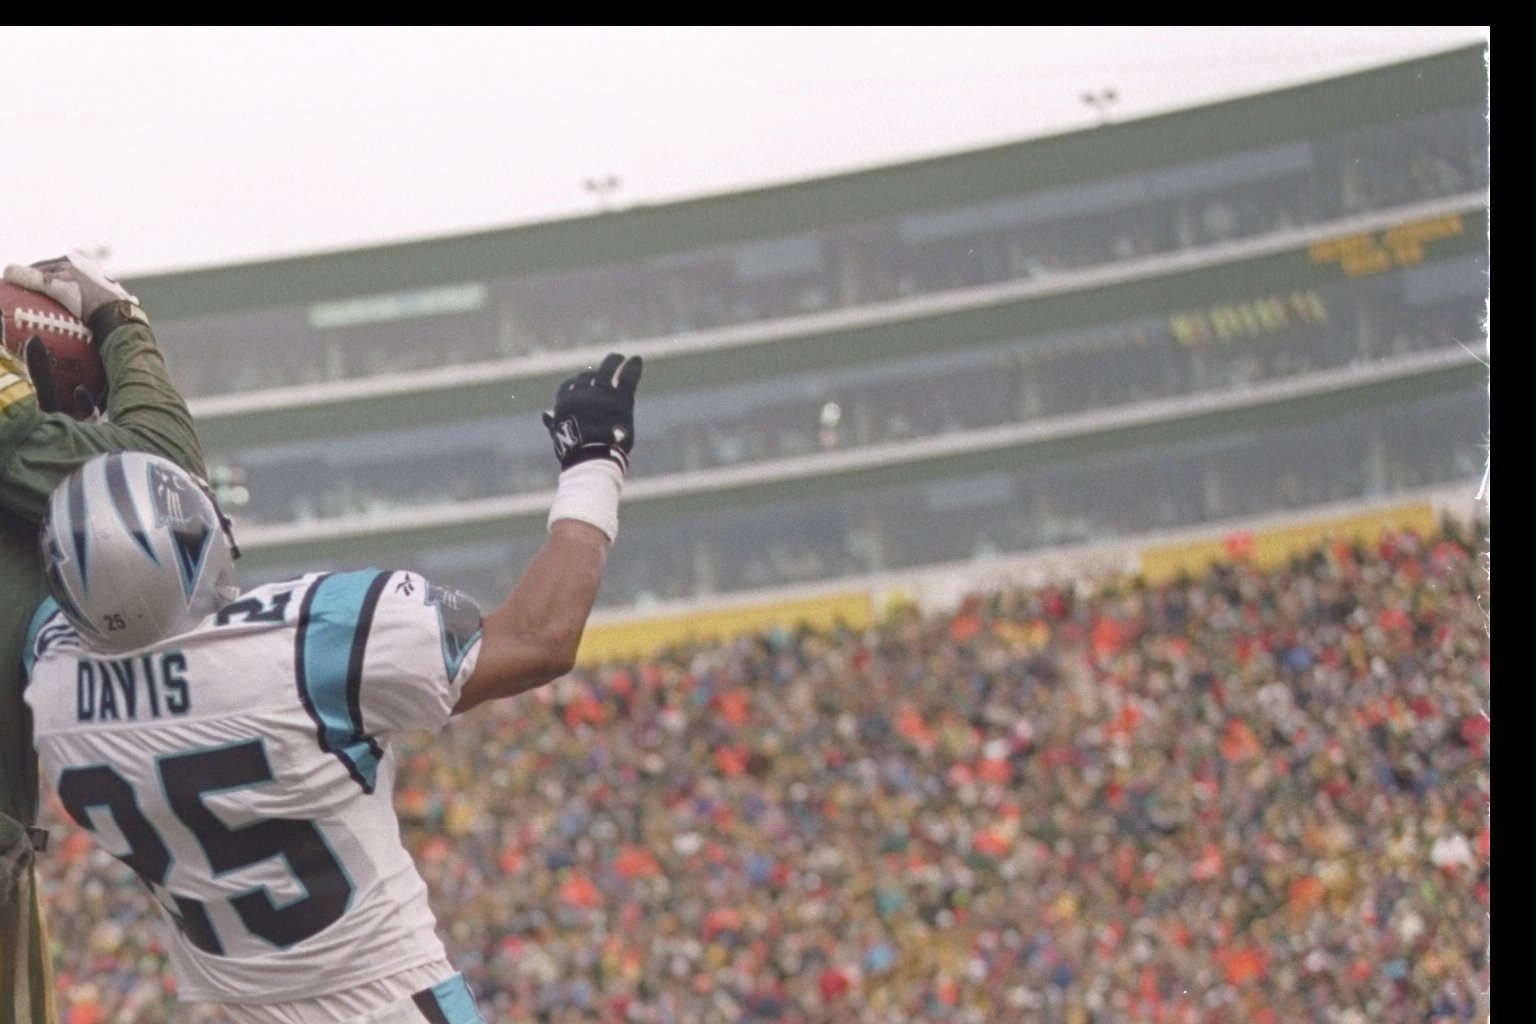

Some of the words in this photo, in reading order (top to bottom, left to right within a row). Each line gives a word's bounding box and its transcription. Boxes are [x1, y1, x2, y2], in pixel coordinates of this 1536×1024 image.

[104, 613, 127, 631] 25
[77, 651, 192, 721] DAVIS
[58, 736, 358, 957] 25
